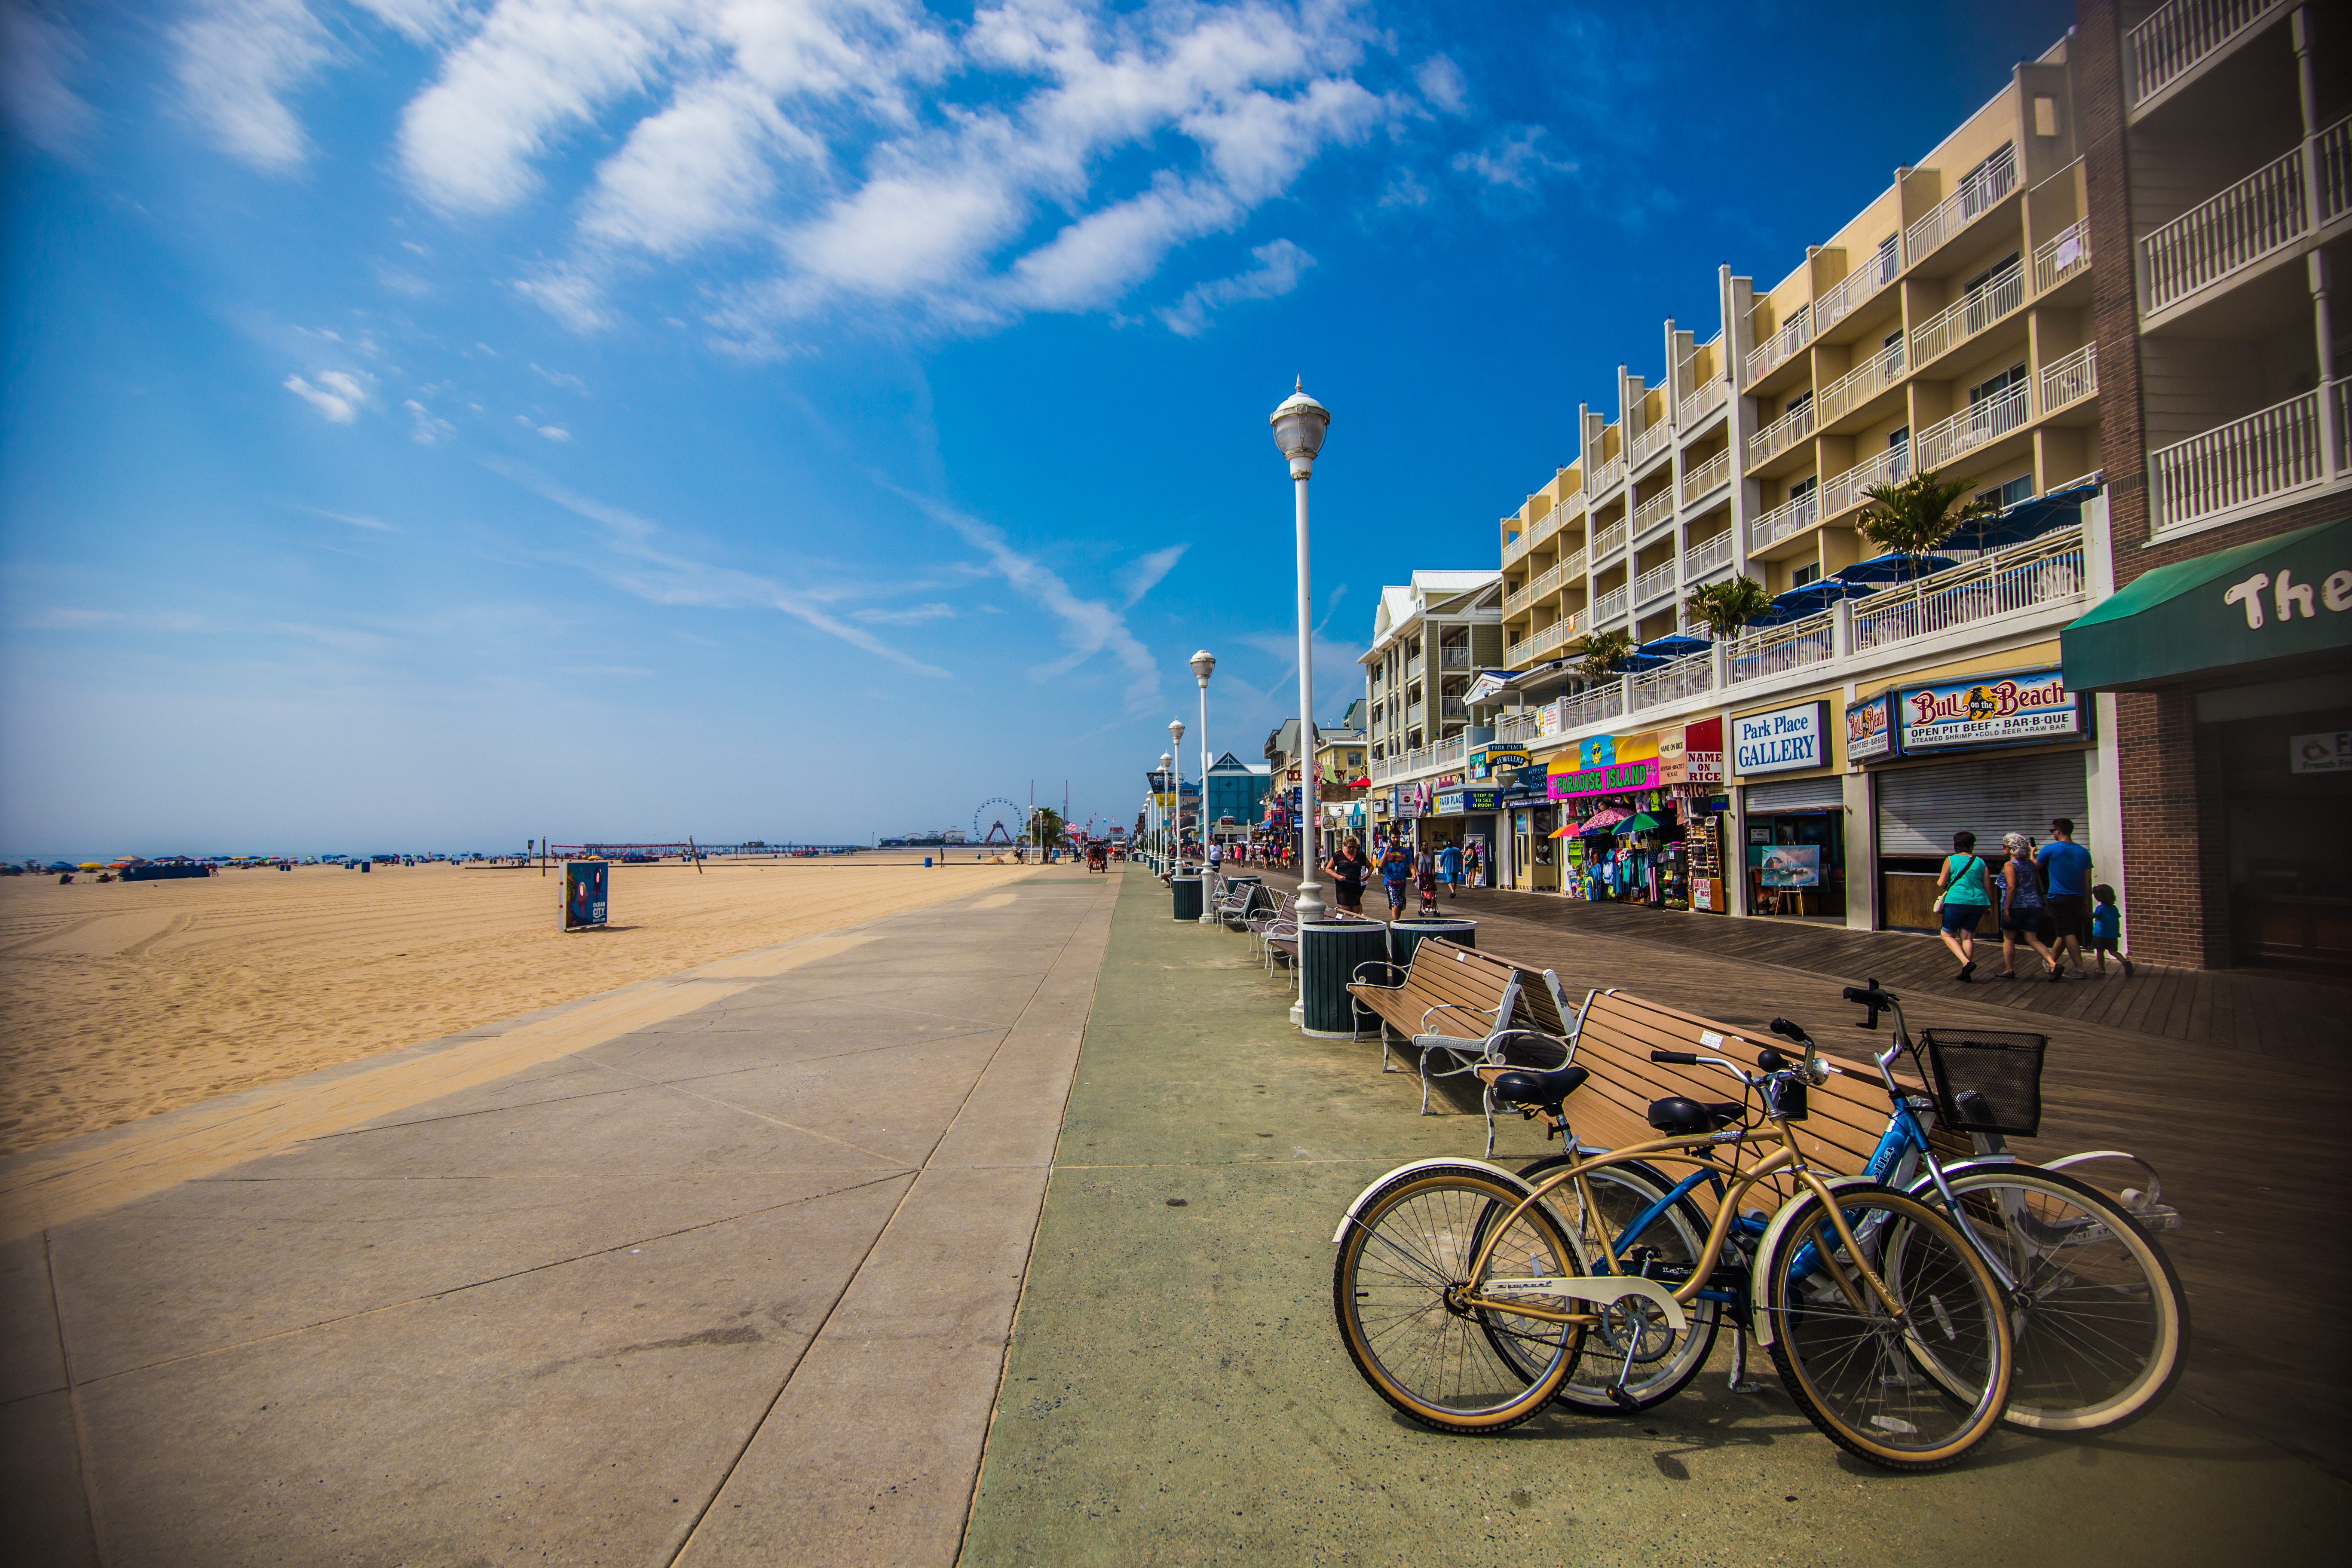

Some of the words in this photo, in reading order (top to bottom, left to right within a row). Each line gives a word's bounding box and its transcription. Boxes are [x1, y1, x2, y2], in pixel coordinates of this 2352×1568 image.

[2223, 569, 2352, 629] The
[1989, 681, 2066, 717] Beach
[1867, 705, 1885, 735] Beach
[1911, 727, 1939, 737] OPEN
[1942, 725, 1960, 734] PIT
[1963, 722, 1991, 732] BEEF
[2004, 714, 2069, 728] BAR-B-QUE
[1743, 719, 1771, 740] Park
[1774, 715, 1808, 735] Place
[1871, 734, 1886, 746] BAR-B-QUE
[1912, 735, 1943, 743] STEAMED
[1688, 753, 1722, 762] NAME
[1739, 734, 1815, 768] GALLERY
[1496, 755, 1524, 765] JEWELERS
[1697, 763, 1710, 772] ON
[1557, 770, 1602, 795] PARADISE
[1606, 764, 1647, 790] ISLAND
[1689, 772, 1721, 781] RICE
[1683, 784, 1709, 797] RICE
[1439, 796, 1449, 806] PARK
[1451, 794, 1463, 805] PLACE
